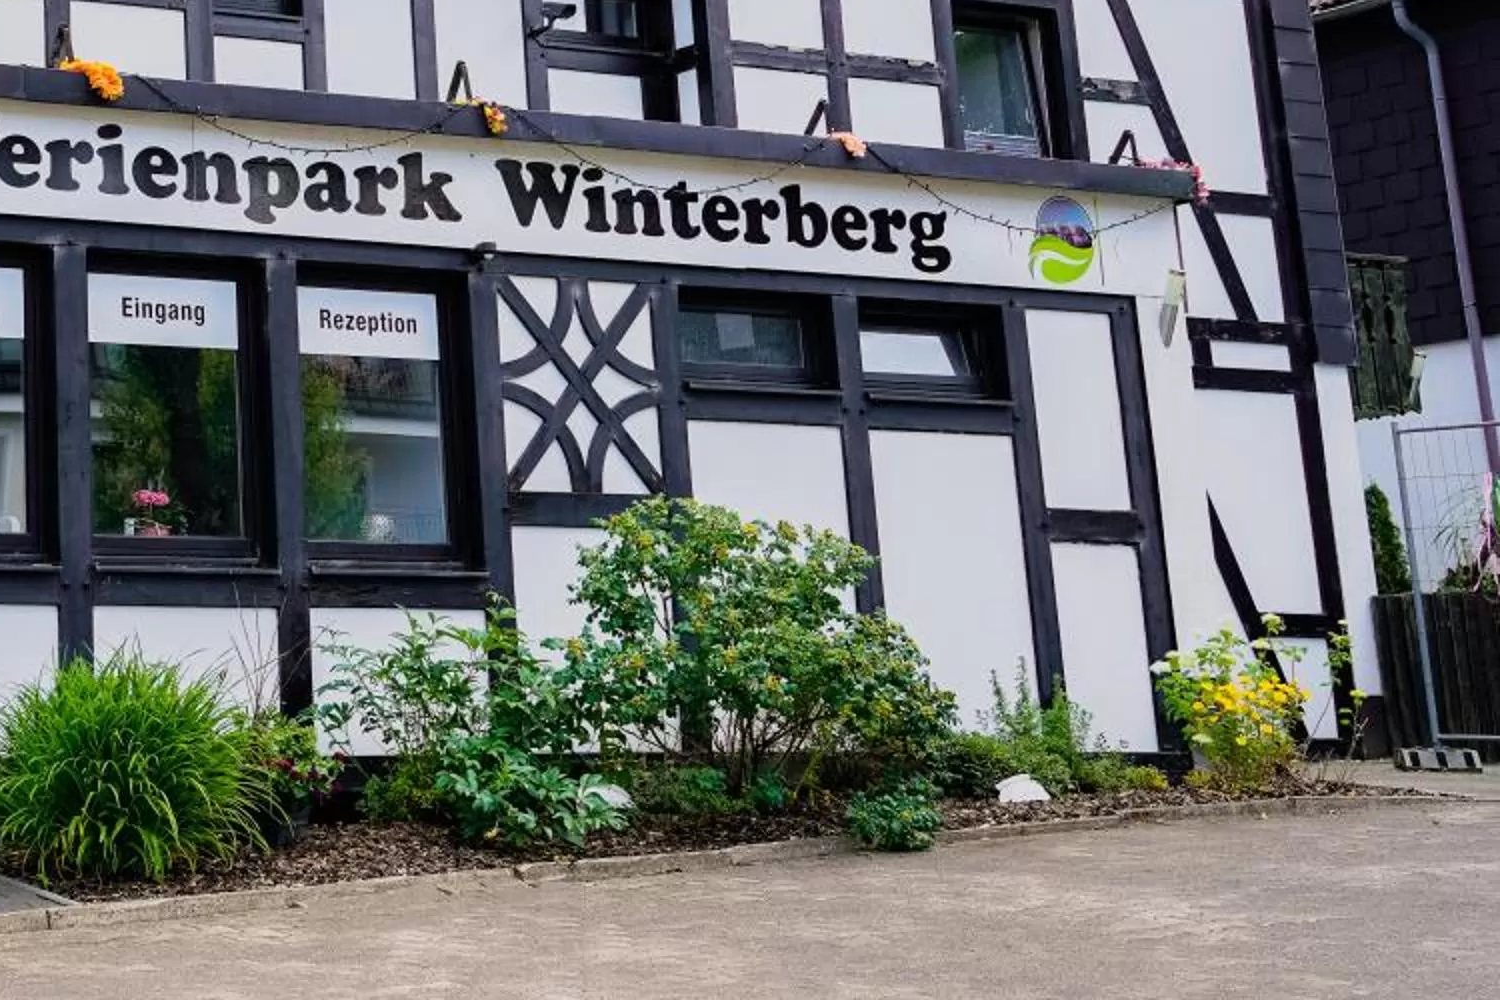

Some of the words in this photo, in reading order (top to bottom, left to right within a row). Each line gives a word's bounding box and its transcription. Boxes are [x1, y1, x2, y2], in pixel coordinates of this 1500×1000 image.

[495, 158, 953, 274] Winterberg
[121, 297, 206, 327] Eingang
[319, 308, 418, 336] Rezeption
